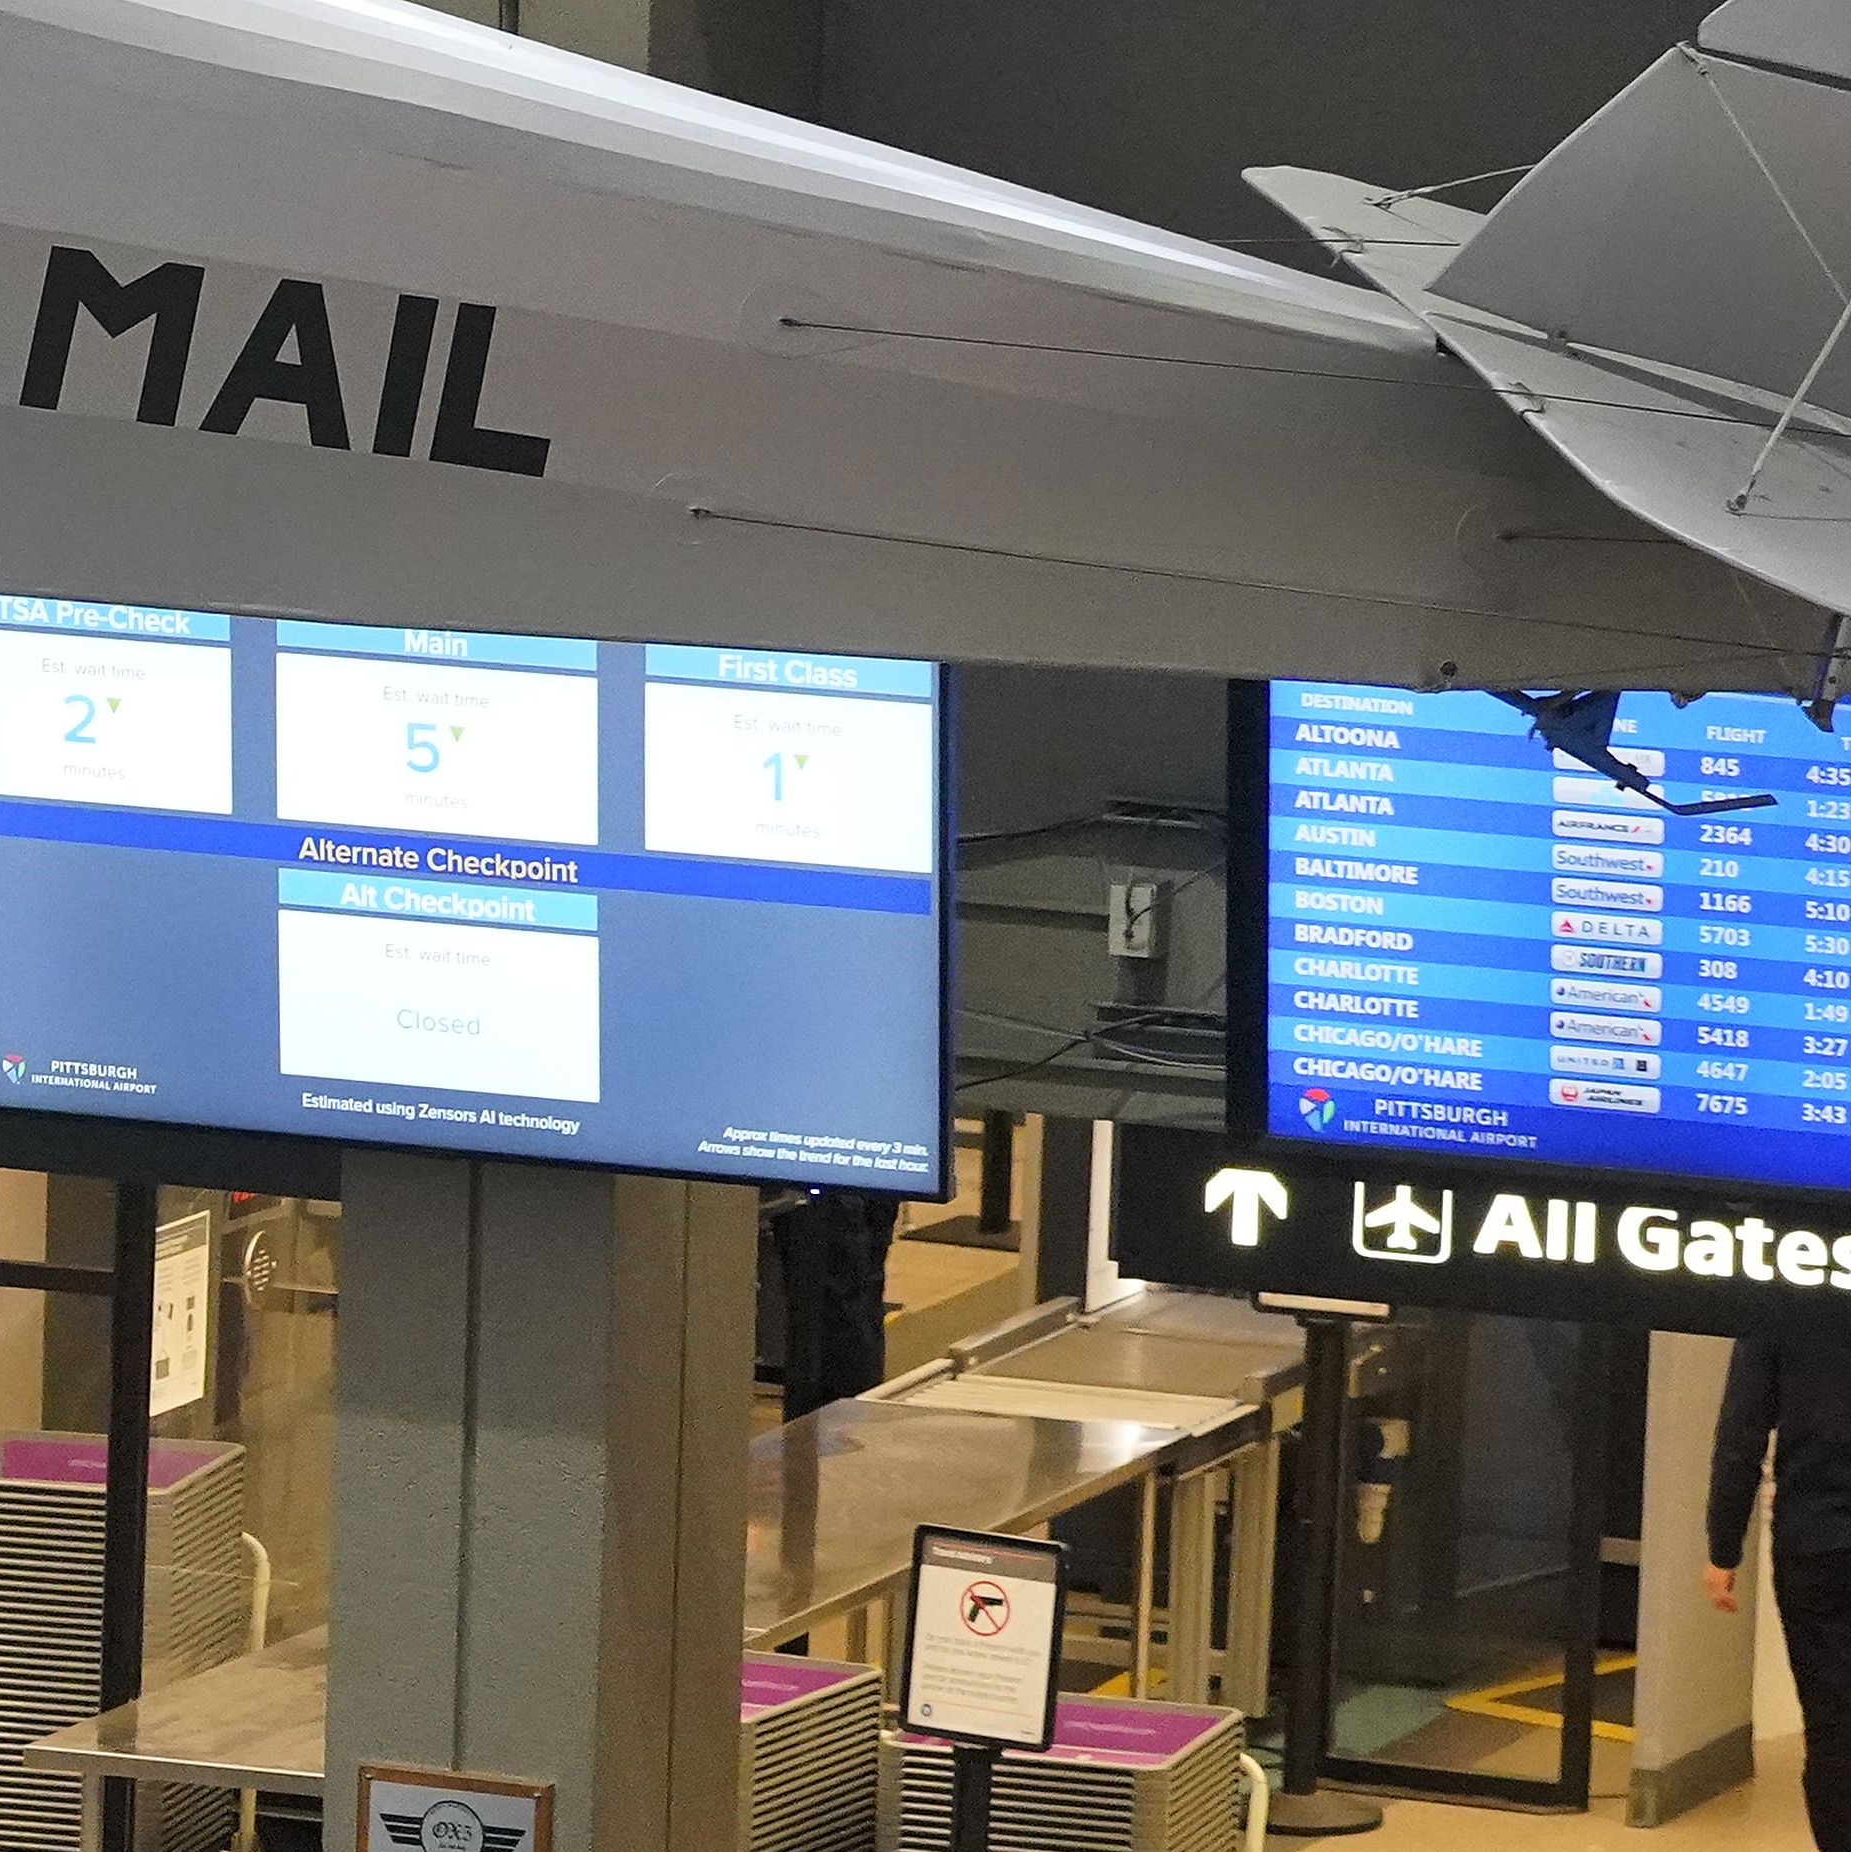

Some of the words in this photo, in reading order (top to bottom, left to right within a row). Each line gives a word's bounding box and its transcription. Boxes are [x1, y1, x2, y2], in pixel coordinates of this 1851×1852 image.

[19, 245, 552, 479] MAIL
[55, 602, 191, 635] Pre-Check
[404, 631, 469, 659] Main
[718, 654, 778, 683] First
[784, 659, 859, 688] Class
[64, 694, 97, 743] 2
[406, 722, 440, 773] 5
[1296, 724, 1400, 748] ALTOONA
[762, 752, 782, 801] 1
[1296, 757, 1394, 781] ATLANTA
[1295, 791, 1394, 815] ATLANTA
[1295, 824, 1376, 847] AUSTIN
[298, 836, 420, 870] Alternate
[427, 846, 579, 885] Checkpoint
[1296, 858, 1418, 884] BALTIMORE
[340, 882, 379, 909] Alt
[384, 887, 536, 925] Checkpoint
[1296, 891, 1383, 915] BOSTON
[1295, 924, 1413, 950] BRADFORD
[1294, 958, 1418, 985] CHARLOTTE
[1294, 991, 1418, 1017] CHARLOTTE
[397, 1009, 483, 1037] Closed
[1294, 1024, 1482, 1057] CHICAGO/O'HARE
[31, 1073, 111, 1090] INTERNATIONAL
[113, 1080, 157, 1094] AIRPORT
[50, 1060, 137, 1081] PITTSBURGH
[1294, 1058, 1482, 1090] CHICAGO/O'HARE
[302, 1092, 373, 1113] Estimated
[375, 1101, 416, 1120] using
[418, 1103, 477, 1122] Zensors
[479, 1109, 496, 1125] AI
[498, 1111, 581, 1137] technology
[1473, 1193, 1596, 1265] All
